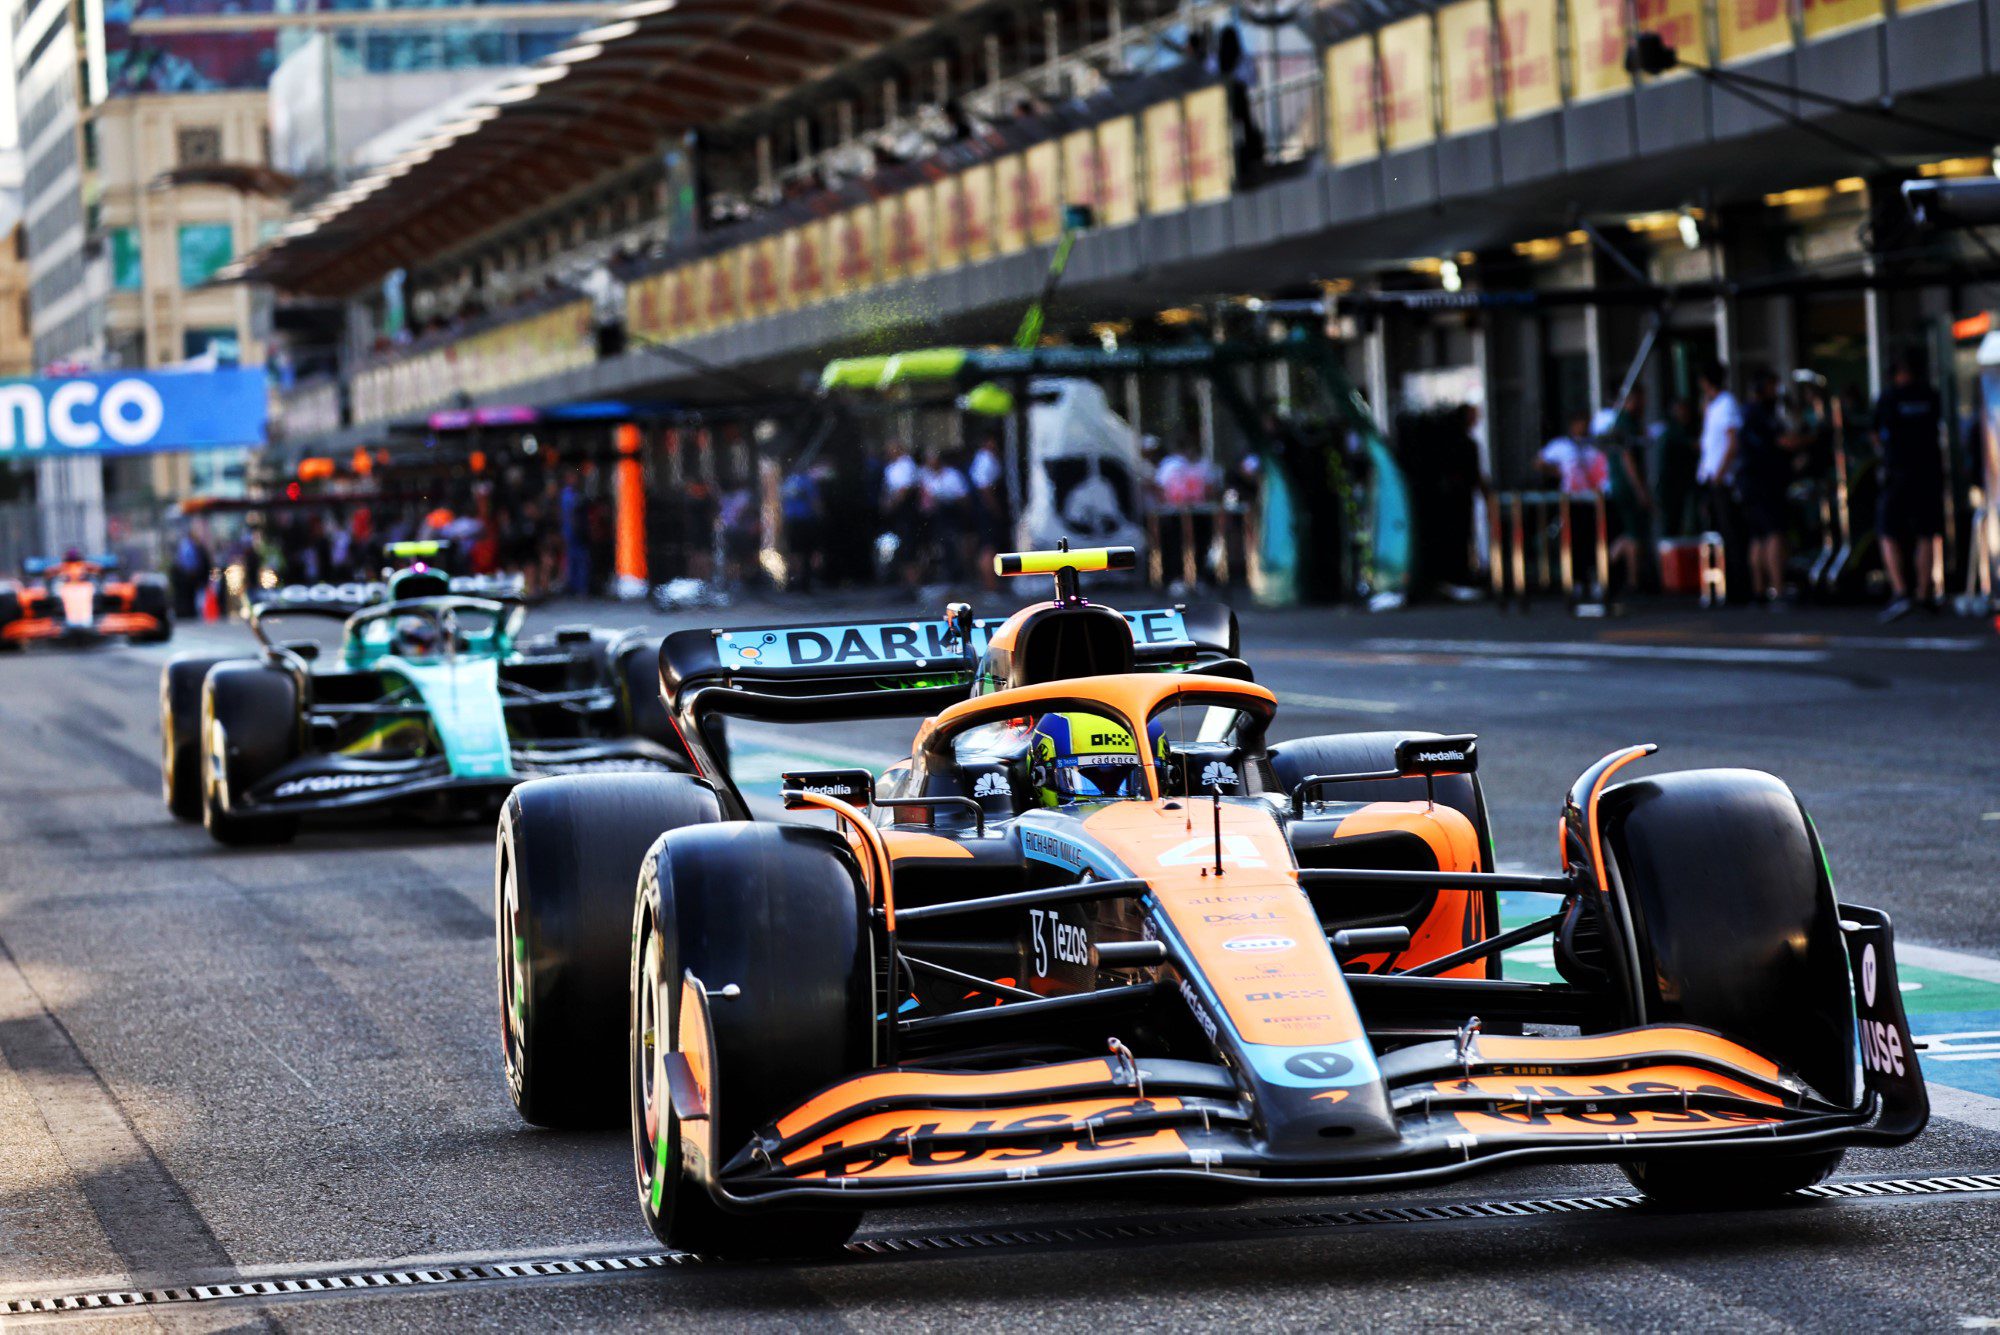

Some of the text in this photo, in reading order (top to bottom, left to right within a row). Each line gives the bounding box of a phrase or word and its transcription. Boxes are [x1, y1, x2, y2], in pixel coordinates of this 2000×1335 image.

[1091, 733, 1129, 746] OKX
[1091, 756, 1134, 765] cadence
[1419, 750, 1465, 761] Medallia
[1201, 777, 1239, 785] CNBC
[803, 784, 851, 795] Medallia
[974, 788, 1013, 797] CNBC
[1026, 832, 1082, 868] RICHARD MILLE
[1157, 835, 1268, 868] 4
[1202, 911, 1288, 923] DELL
[1049, 910, 1088, 966] Tezos
[1225, 939, 1291, 949] Gulf
[1245, 989, 1329, 1002] OKX
[1180, 978, 1218, 1045] McLaren
